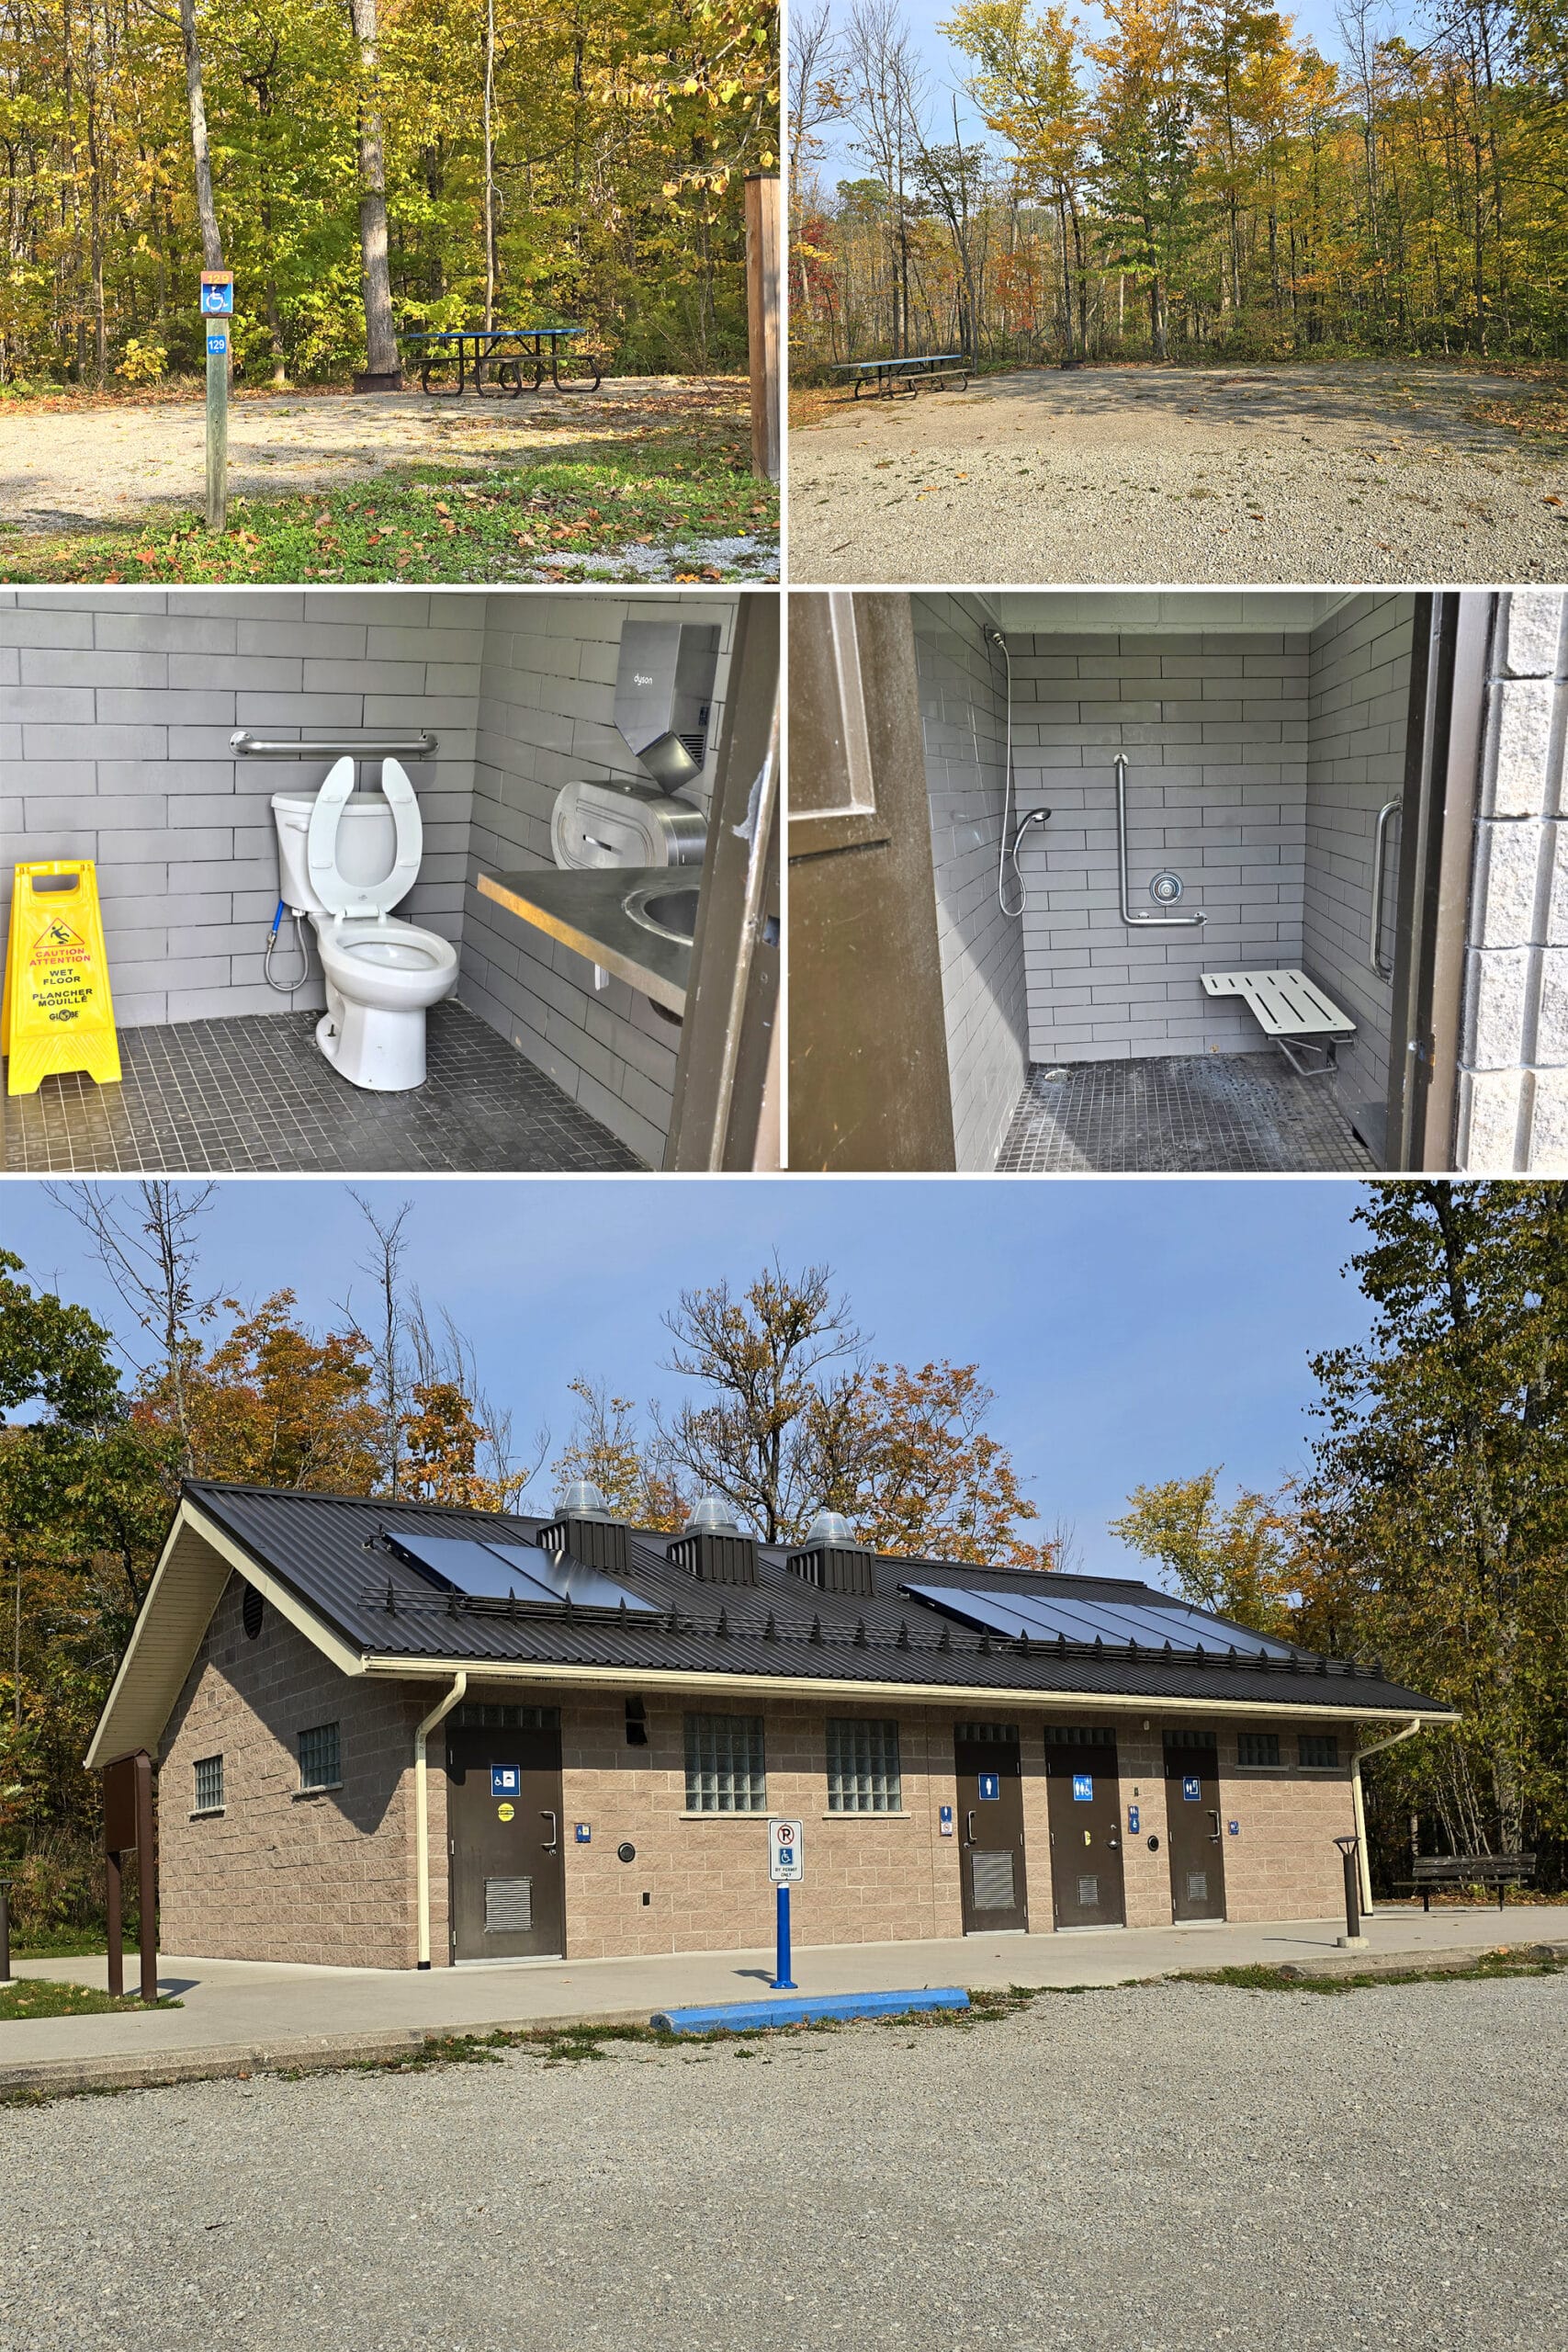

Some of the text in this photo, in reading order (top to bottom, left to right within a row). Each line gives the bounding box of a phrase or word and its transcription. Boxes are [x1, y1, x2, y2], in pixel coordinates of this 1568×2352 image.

[208, 275, 229, 284] 129
[209, 340, 224, 349] 129
[634, 673, 652, 685] dyson
[35, 948, 85, 958] CAUTION
[29, 956, 91, 967] ATTENTION
[50, 968, 73, 977] WET
[43, 976, 81, 985] FLOOR
[32, 988, 93, 1000] PLANCHER
[38, 995, 88, 1007] MOUILLÉ
